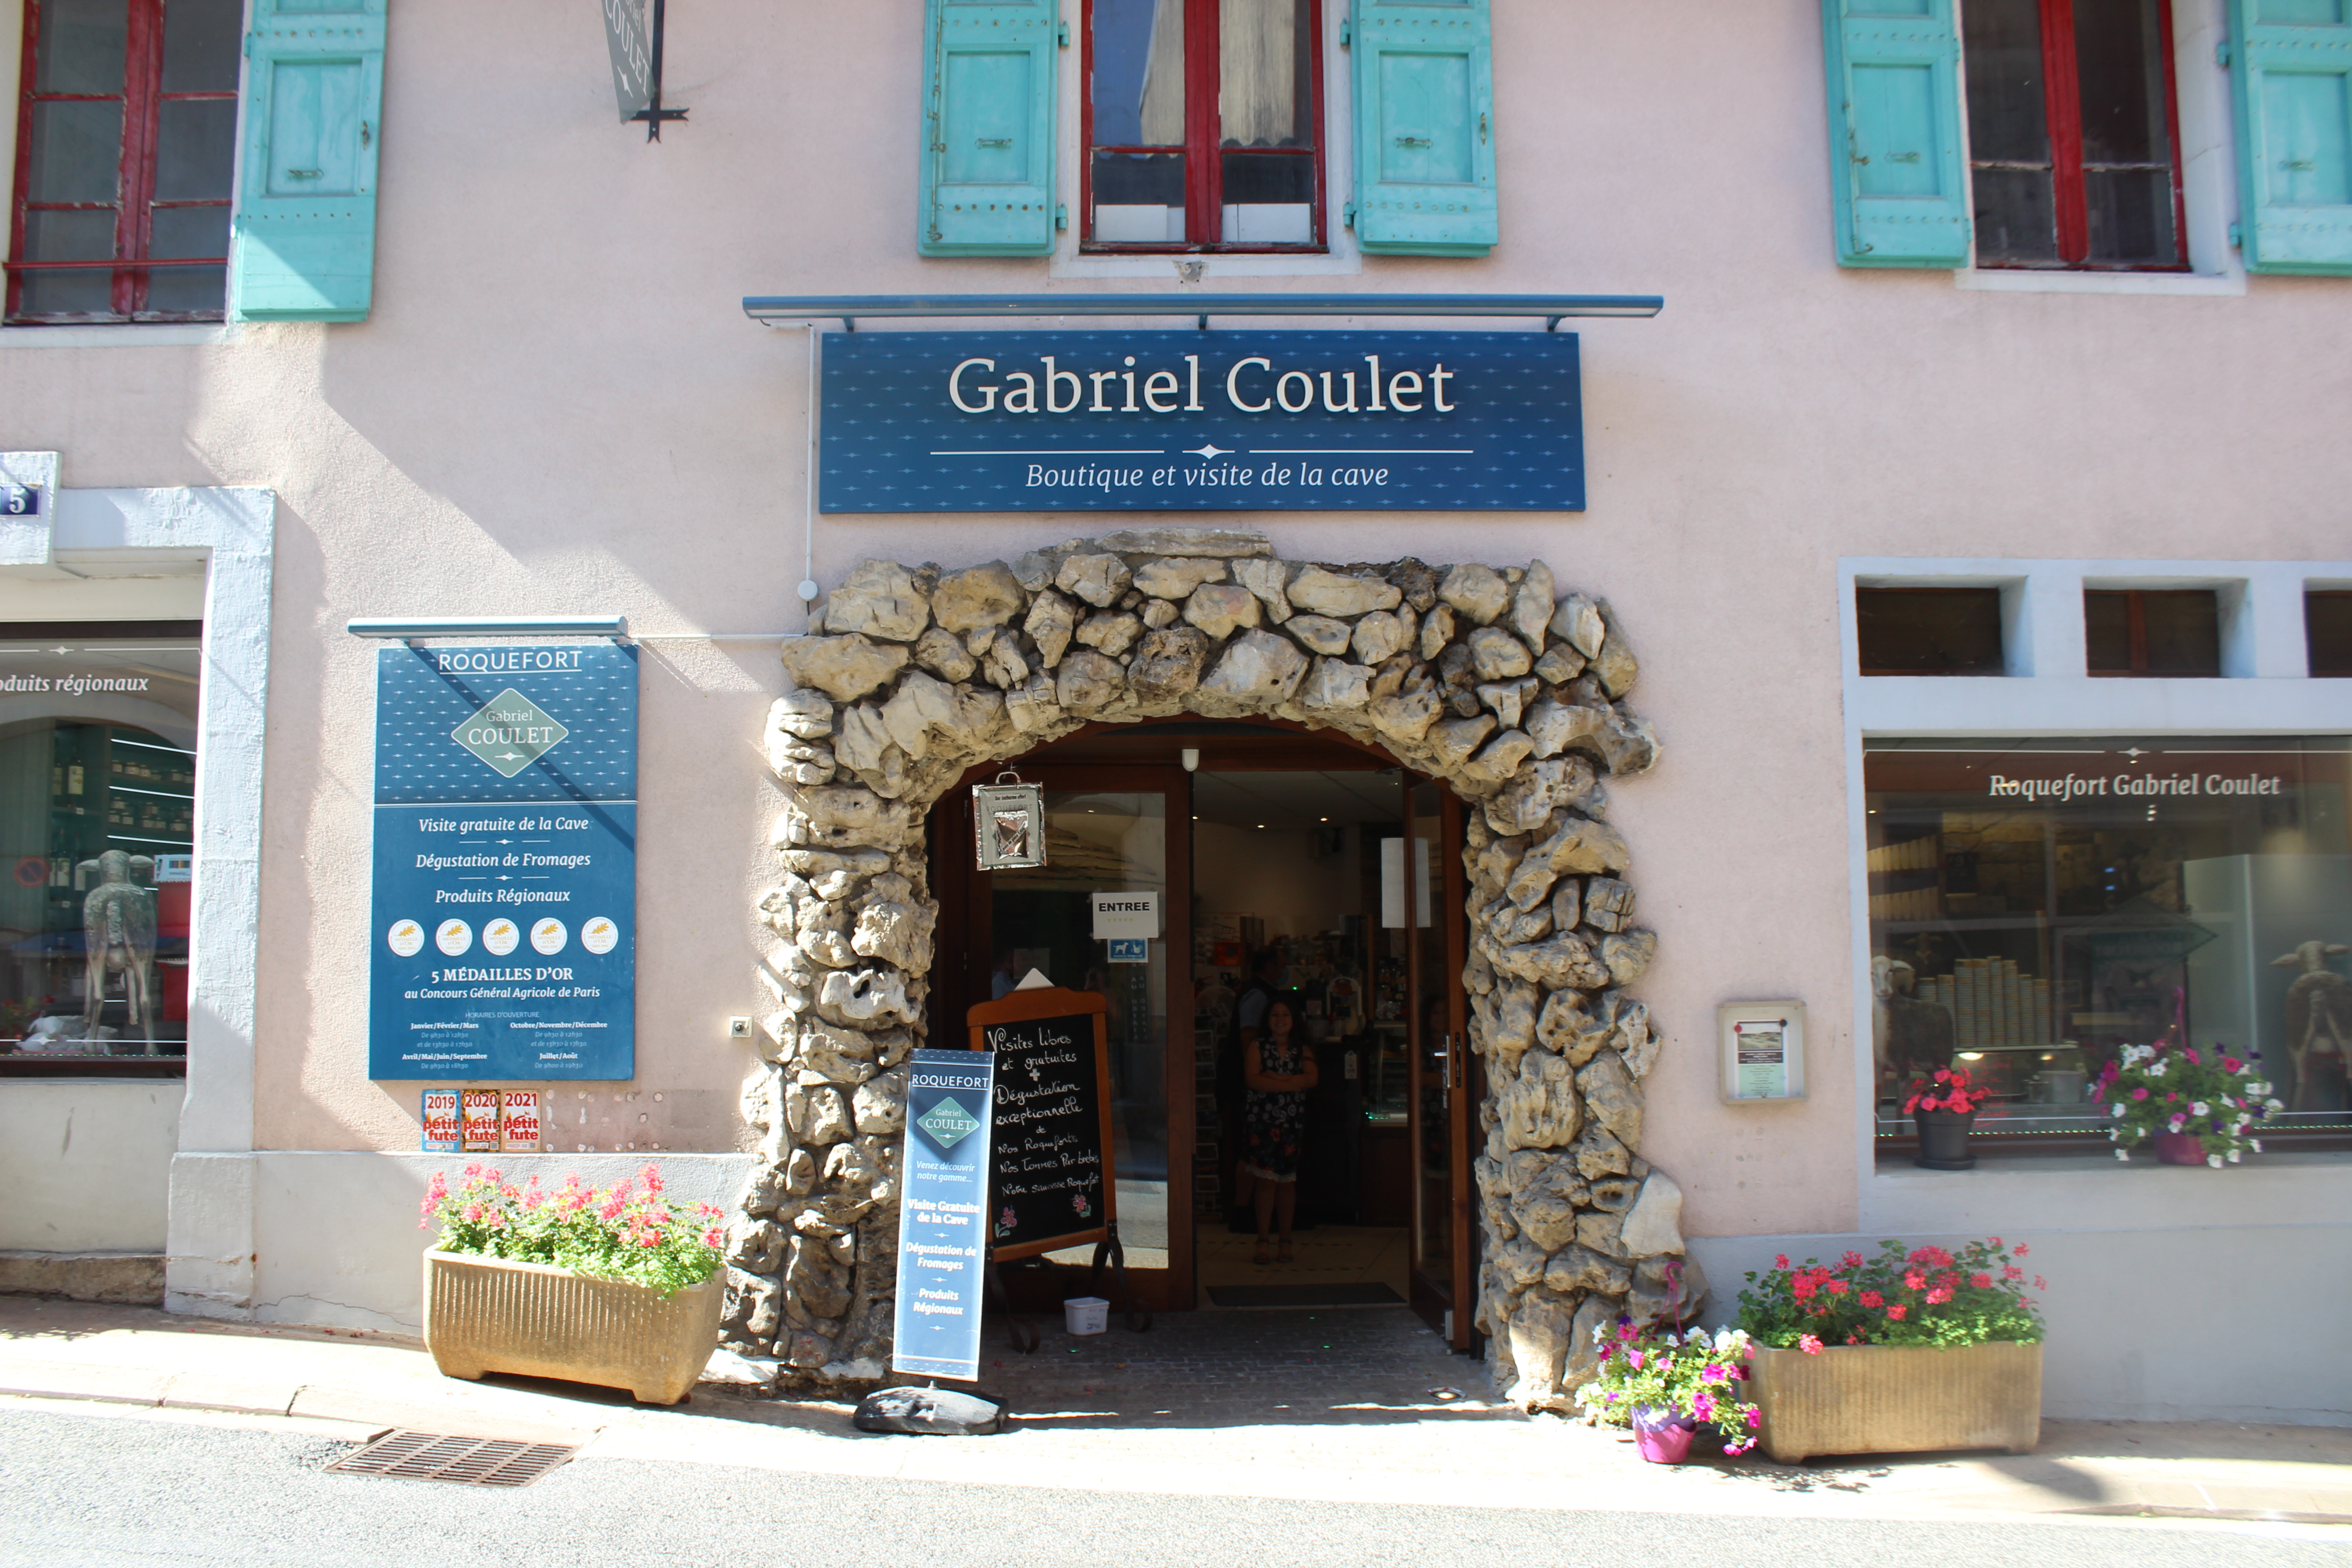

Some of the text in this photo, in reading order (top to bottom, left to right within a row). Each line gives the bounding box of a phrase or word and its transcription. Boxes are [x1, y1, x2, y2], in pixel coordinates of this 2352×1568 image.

[946, 354, 1456, 415] Gabriel Coulet
[1026, 462, 1389, 494] Boutique et visite de la cave
[9, 490, 26, 513] 5
[439, 650, 583, 672] ROQUEFORT
[54, 673, 149, 696] régionaux
[487, 710, 533, 722] Gabriel
[469, 727, 554, 746] COULET
[1989, 773, 2282, 802] Roquefort Gabriel Coulet
[986, 804, 1033, 813] ROQUEFORT
[419, 817, 589, 835] Visite gratuite de la Cave
[416, 853, 591, 872] Dégustation de Fromages
[436, 888, 571, 906] Produits Régionaux
[1098, 902, 1150, 912] ENTREE
[432, 971, 440, 984] 5
[444, 967, 533, 982] MÉDAILLES
[405, 987, 601, 1001] au Concours Général Agricole de Paris
[411, 1022, 479, 1030] Janvier/Février/Mars
[510, 1021, 608, 1029] Octobre/Novembre/Décembre
[988, 1027, 1072, 1054] Visites libres
[402, 1053, 488, 1061] Avril/Mai/Juin/Septembre
[539, 1052, 578, 1060] Juillet/Août
[1002, 1049, 1077, 1070] et gratuites
[912, 1074, 989, 1088] ROQUEFORT
[505, 1093, 537, 1107] 2021
[994, 1081, 1081, 1105] Dégustation
[427, 1096, 455, 1109] 2019
[464, 1093, 498, 1108] 2020
[935, 1108, 962, 1117] Gabriel
[995, 1096, 1083, 1126] exceptionnelle
[423, 1118, 459, 1132] petit
[463, 1117, 499, 1132] petit
[504, 1117, 539, 1131] petit
[925, 1118, 972, 1131] COULET
[1036, 1126, 1046, 1134] de
[998, 1143, 1019, 1154] Nos
[916, 1160, 975, 1172] Venez découvrir
[1000, 1161, 1019, 1174] Nos
[906, 1198, 981, 1214] Visite Gratuite
[916, 1211, 969, 1225] de la Cave
[905, 1241, 977, 1257] Dégustation de
[916, 1256, 964, 1272] Fromages
[918, 1287, 959, 1301] Produits
[913, 1301, 964, 1316] Régionaux
